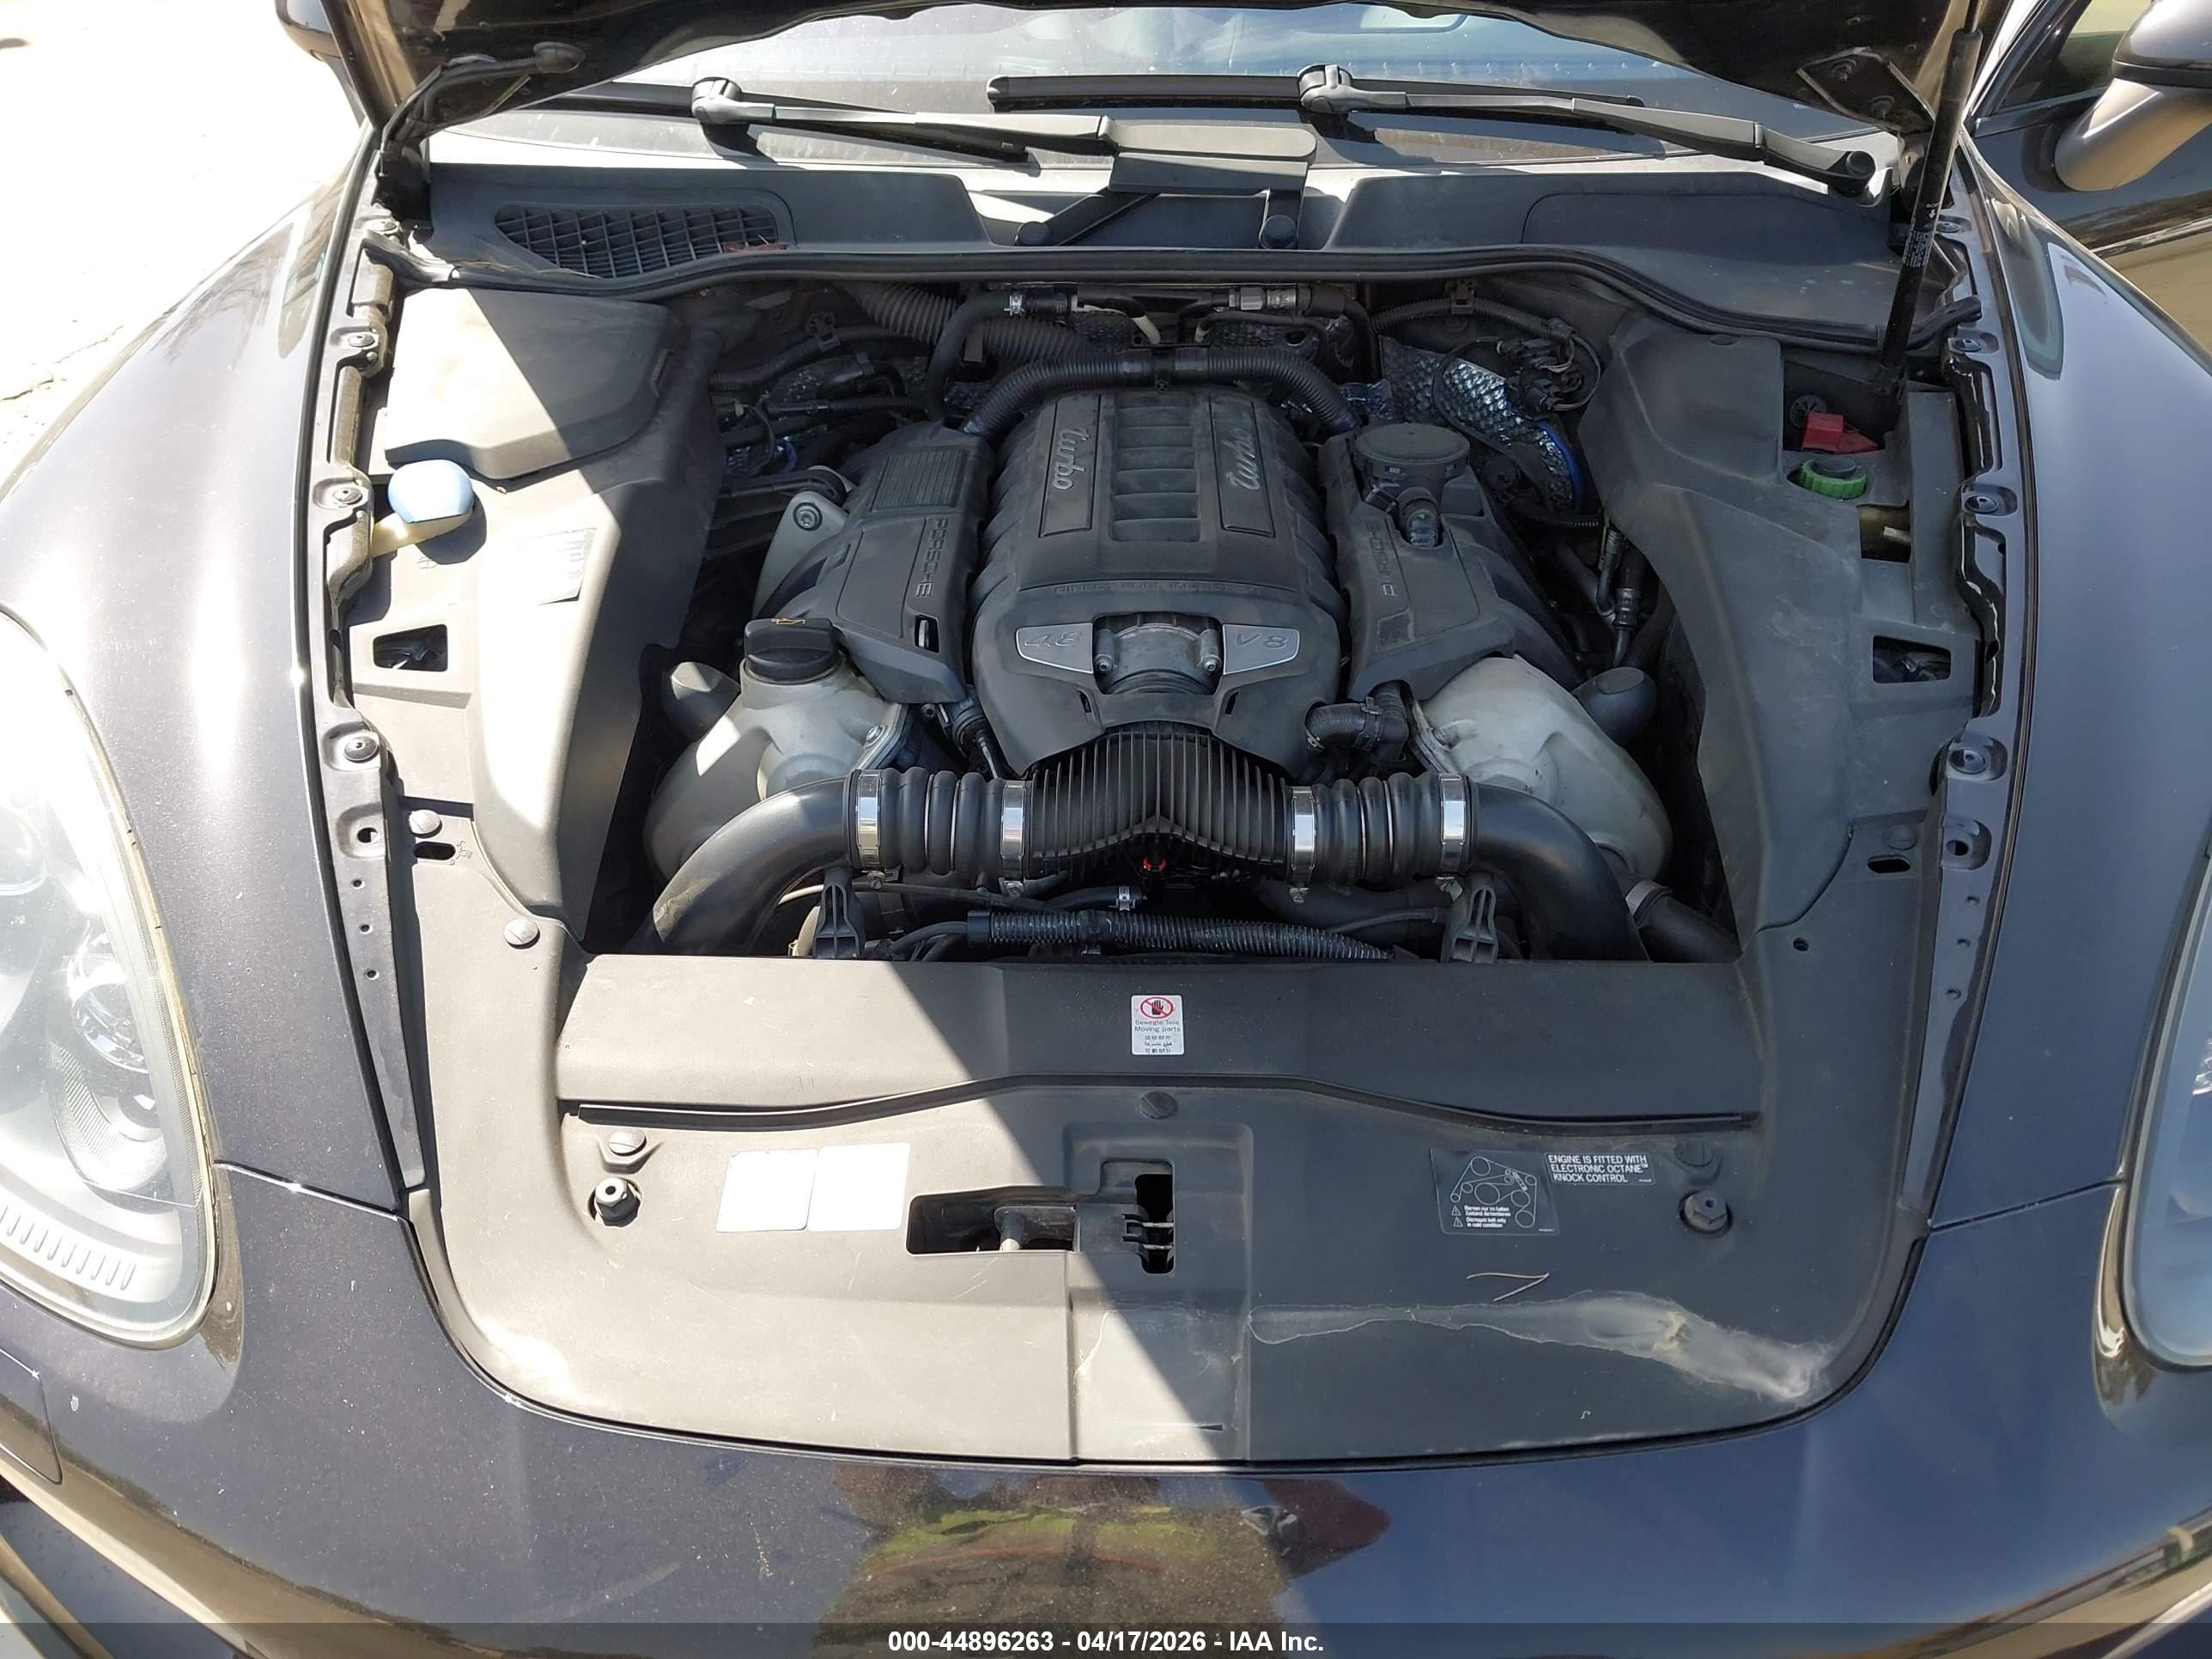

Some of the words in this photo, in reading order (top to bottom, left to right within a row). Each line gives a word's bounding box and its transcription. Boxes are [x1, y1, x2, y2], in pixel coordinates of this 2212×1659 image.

[1053, 428, 1091, 489] turbo
[1226, 428, 1261, 490] turbo
[915, 518, 948, 597] PORSCHE
[1548, 1155, 1581, 1164] ENGINE
[1583, 1155, 1591, 1164] IS
[1593, 1155, 1623, 1164] FITTED
[1624, 1155, 1647, 1164] WITH
[1551, 1164, 1605, 1173] ELECTRONIC
[1553, 1173, 1584, 1182] KNOCK
[1586, 1174, 1628, 1182] CONTROL
